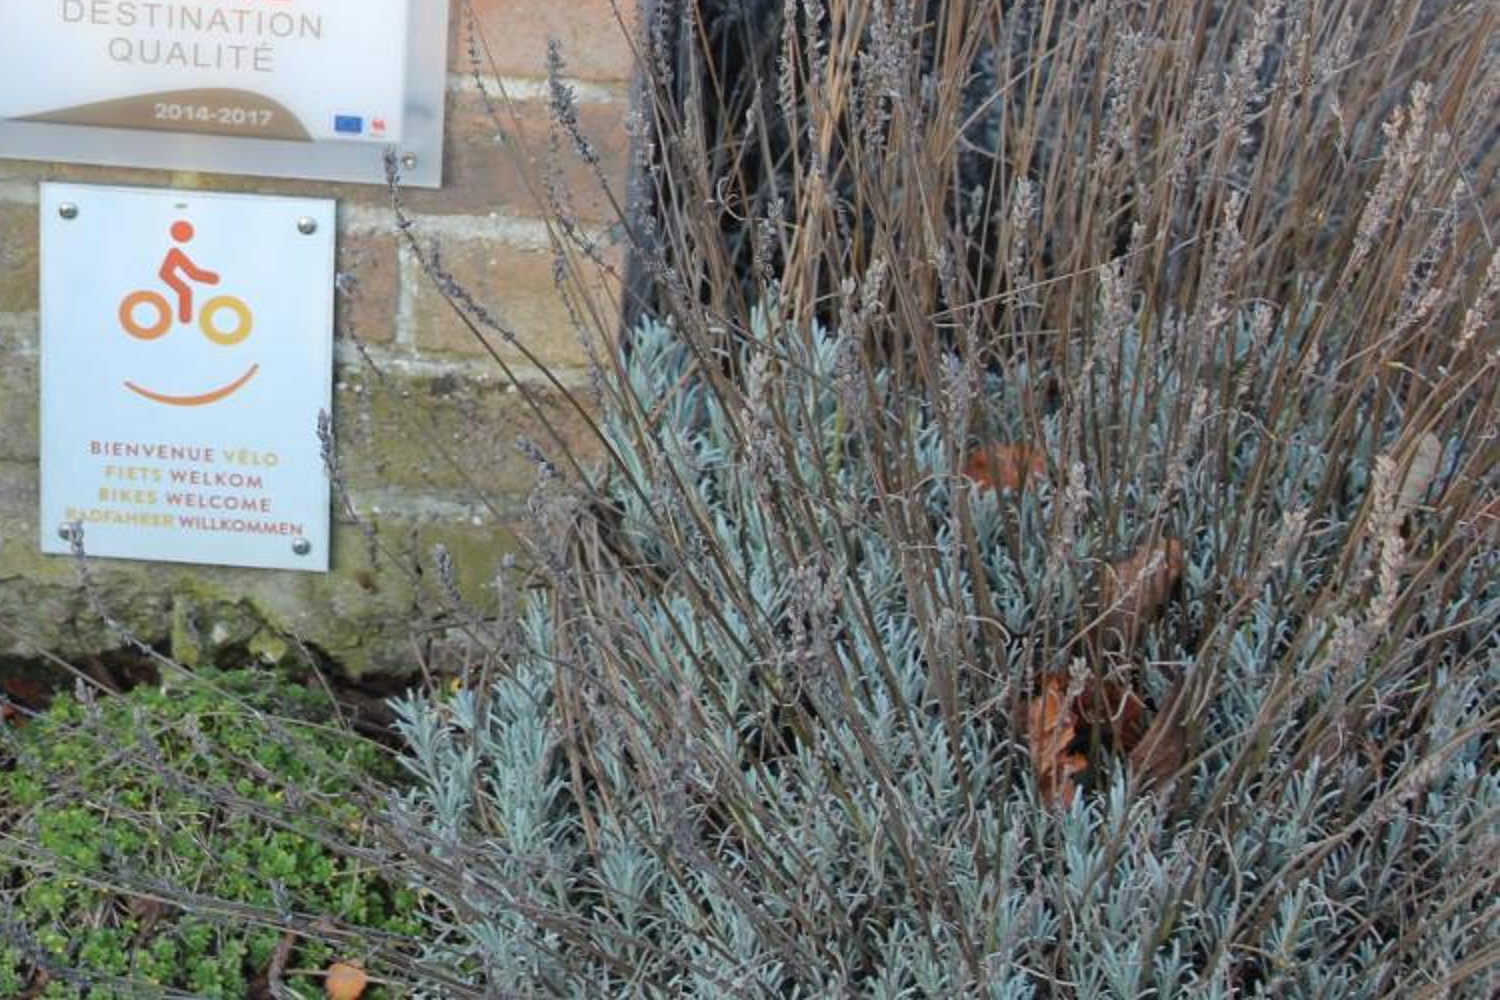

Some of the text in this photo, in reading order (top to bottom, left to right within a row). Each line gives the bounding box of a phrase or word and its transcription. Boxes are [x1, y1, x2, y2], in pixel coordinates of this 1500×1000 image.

[108, 37, 275, 72] QUALITÉ
[155, 103, 273, 126] 2014-2017
[90, 440, 279, 467] BIENVENUE VÉLO
[105, 465, 263, 489] FIETS WELKOM
[99, 487, 271, 513] BIKES WELCOME
[179, 515, 303, 536] WILLKOMMEN
